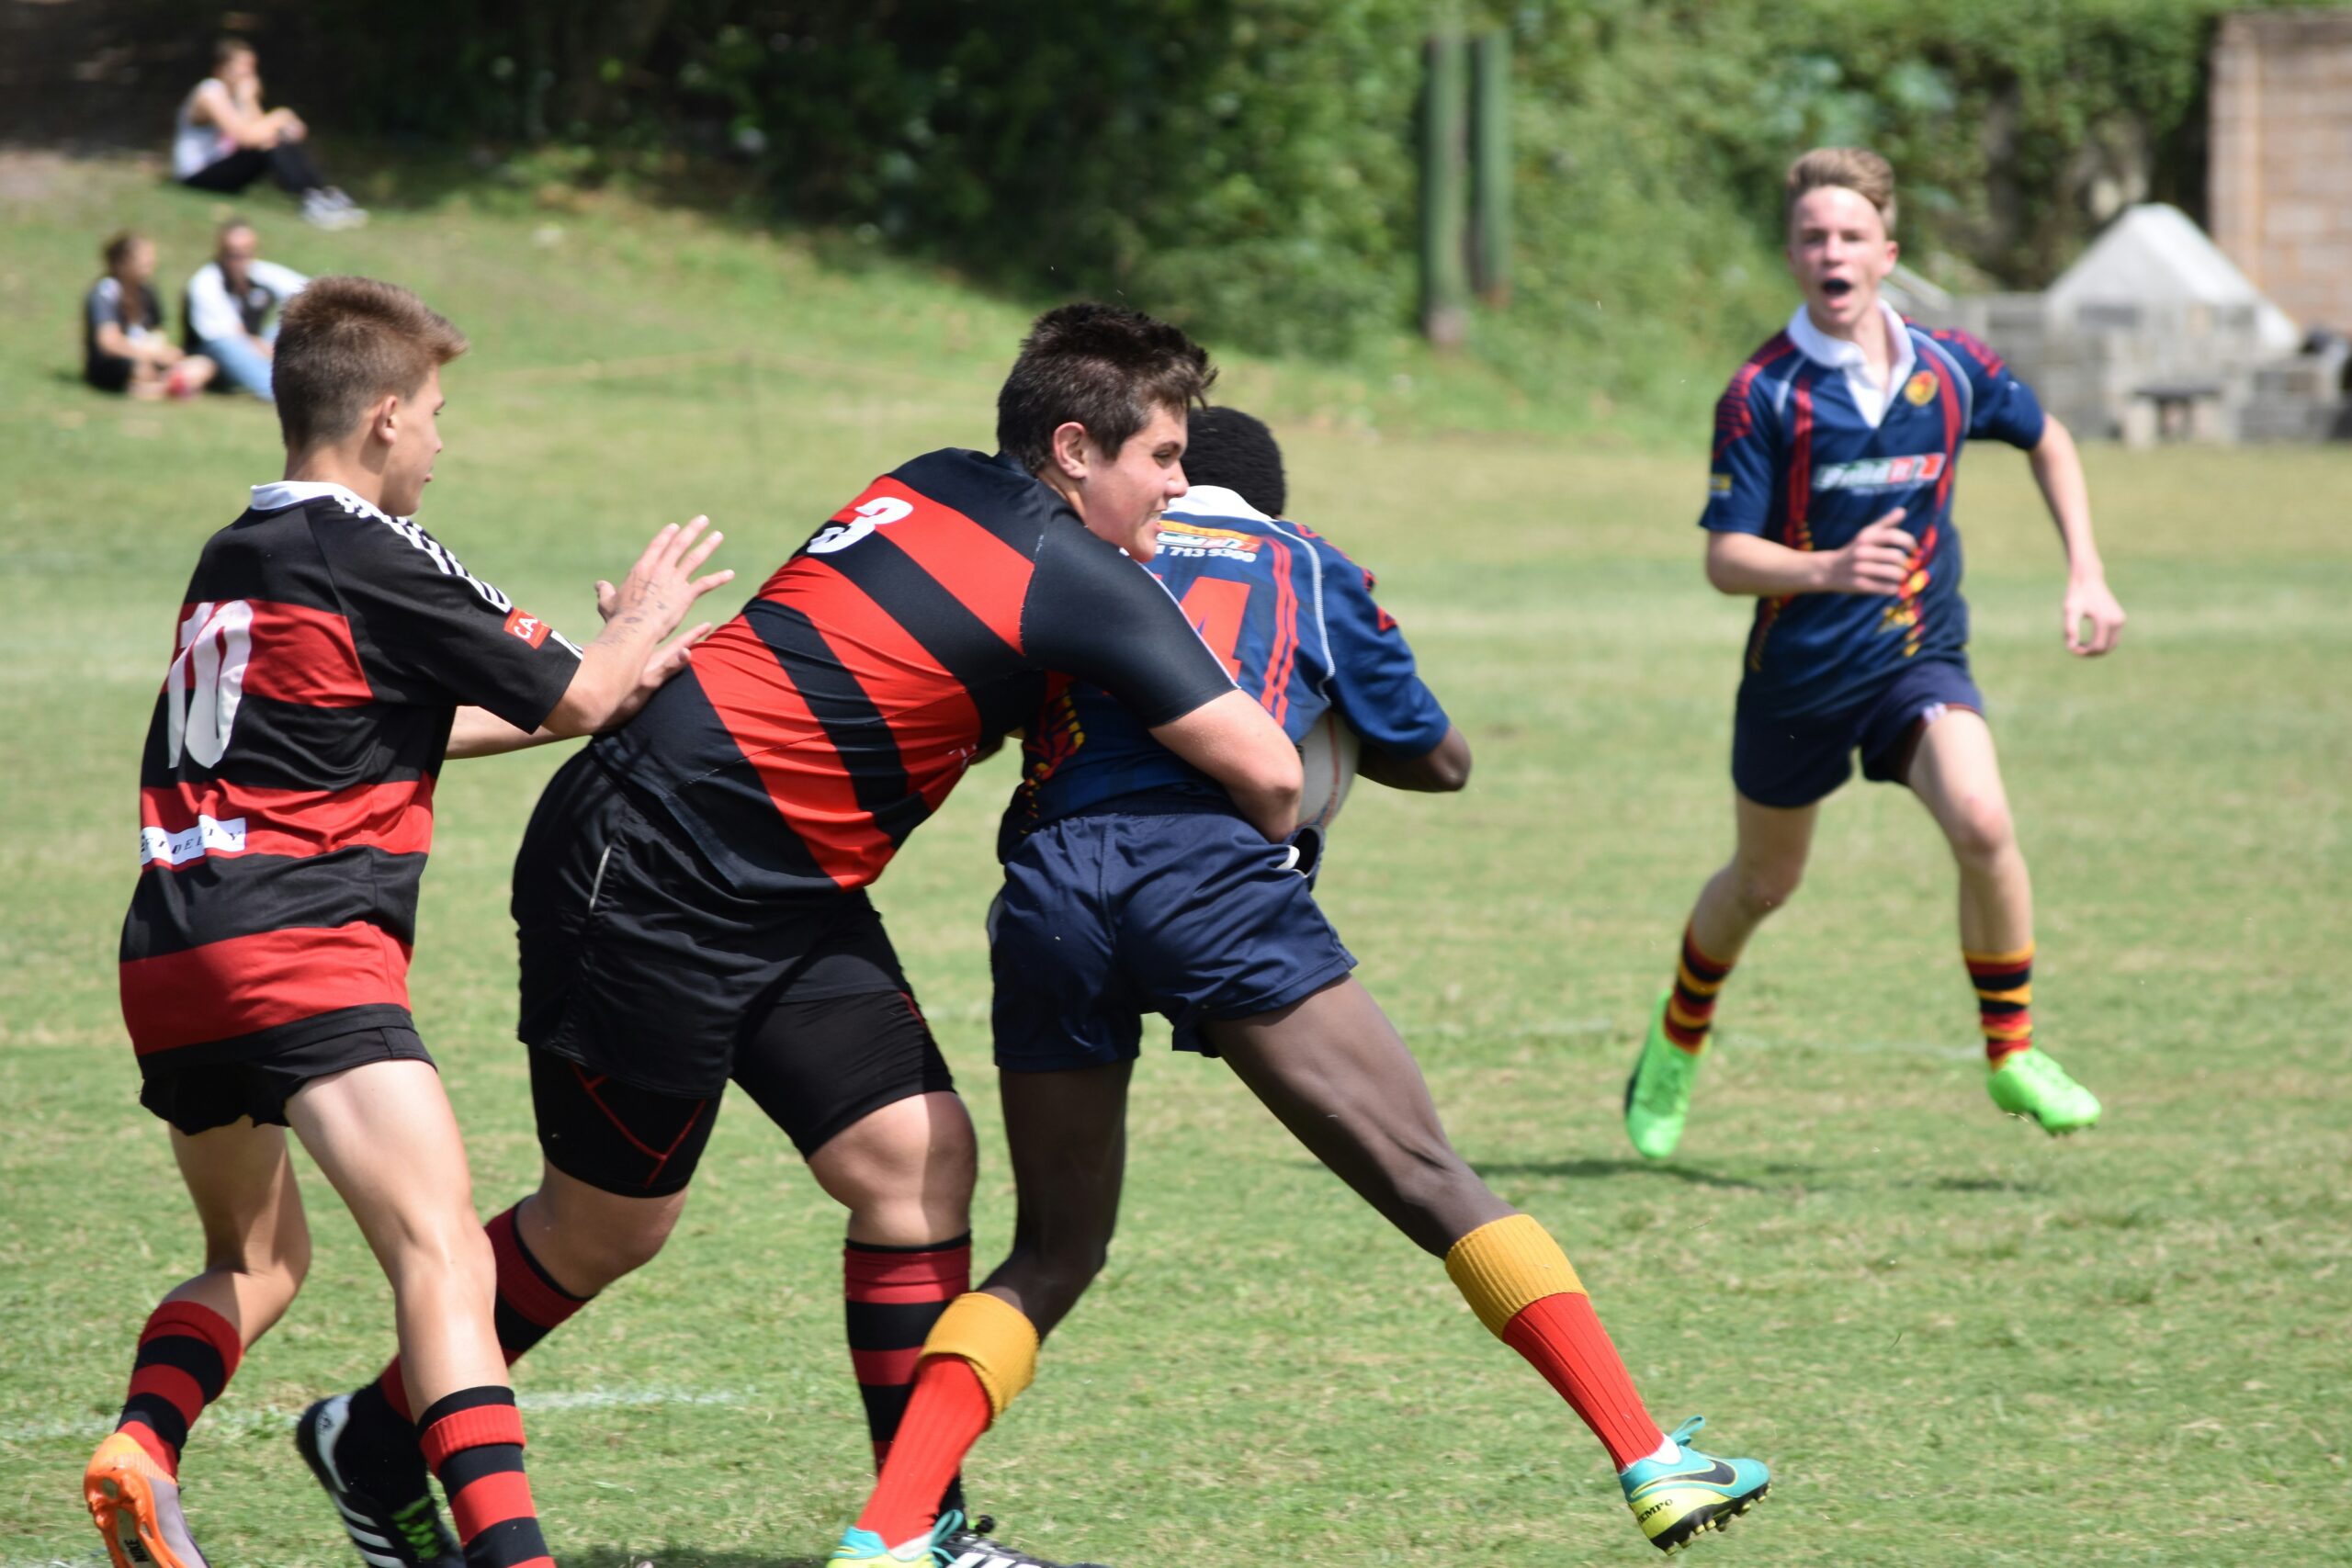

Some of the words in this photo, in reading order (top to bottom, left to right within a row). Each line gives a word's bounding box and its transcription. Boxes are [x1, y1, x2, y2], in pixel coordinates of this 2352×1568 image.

[807, 496, 915, 554] 3
[1170, 546, 1206, 558] 713
[166, 599, 254, 770] 10
